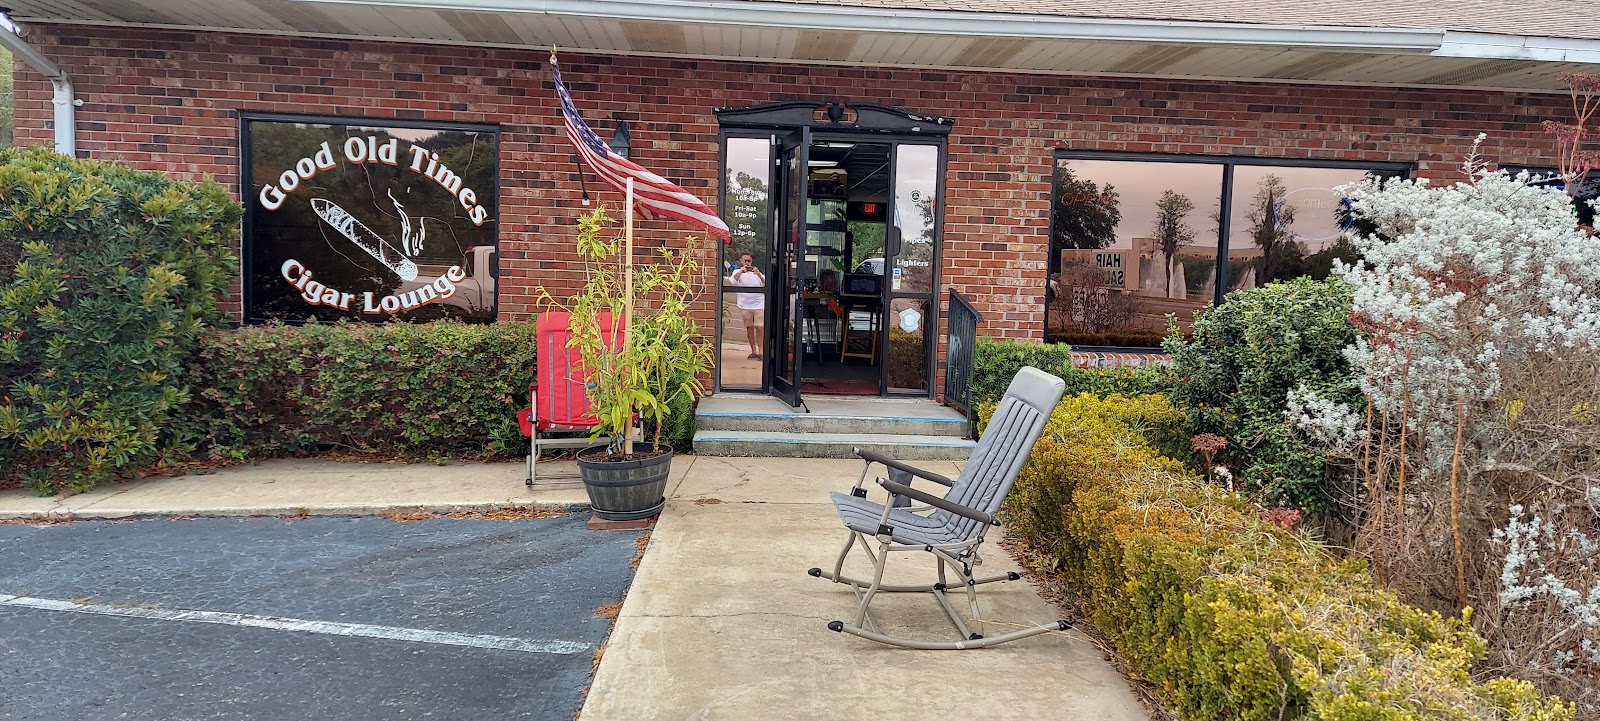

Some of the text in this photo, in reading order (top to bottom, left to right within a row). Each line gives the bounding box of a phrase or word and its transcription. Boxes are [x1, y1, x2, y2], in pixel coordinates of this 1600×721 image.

[259, 135, 489, 227] Good Old Times
[864, 203, 876, 213] EXIT
[896, 259, 929, 267] Lighters
[280, 258, 466, 315] Cigar Lounge
